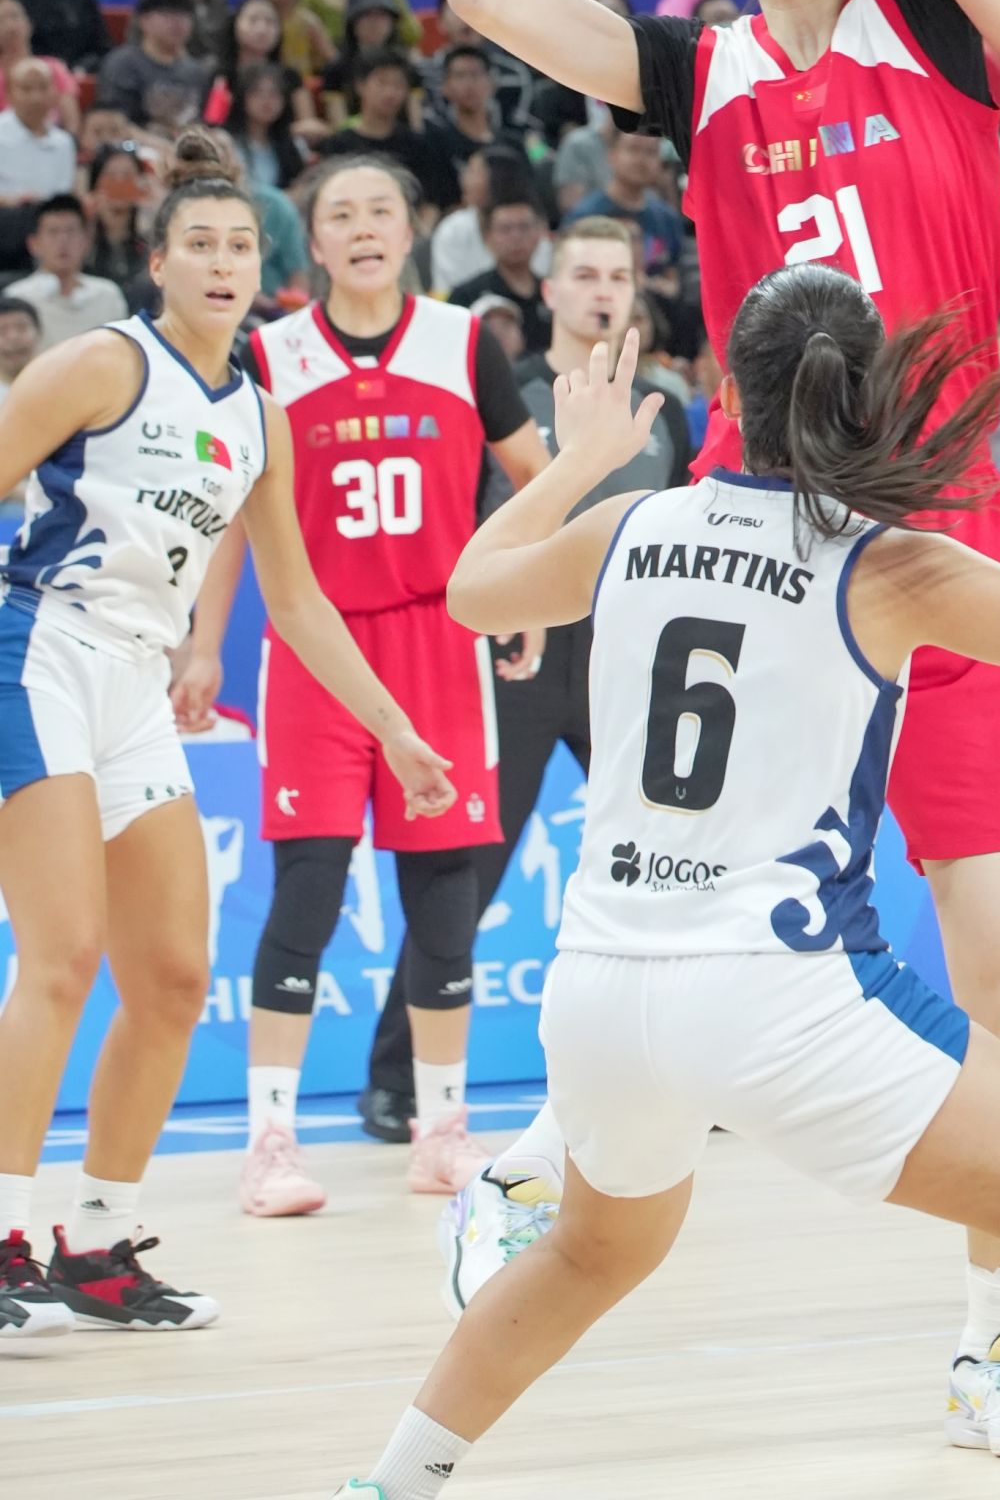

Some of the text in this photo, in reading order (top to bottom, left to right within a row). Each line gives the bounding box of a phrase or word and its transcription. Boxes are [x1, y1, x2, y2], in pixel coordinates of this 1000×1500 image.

[743, 114, 901, 176] CHINA
[777, 184, 884, 294] 21
[305, 415, 440, 448] CHINA
[331, 457, 423, 539] 30
[729, 516, 764, 528] FISU
[624, 543, 815, 604] MARTINS
[638, 616, 747, 815] 6
[645, 852, 728, 884] JOGOS
